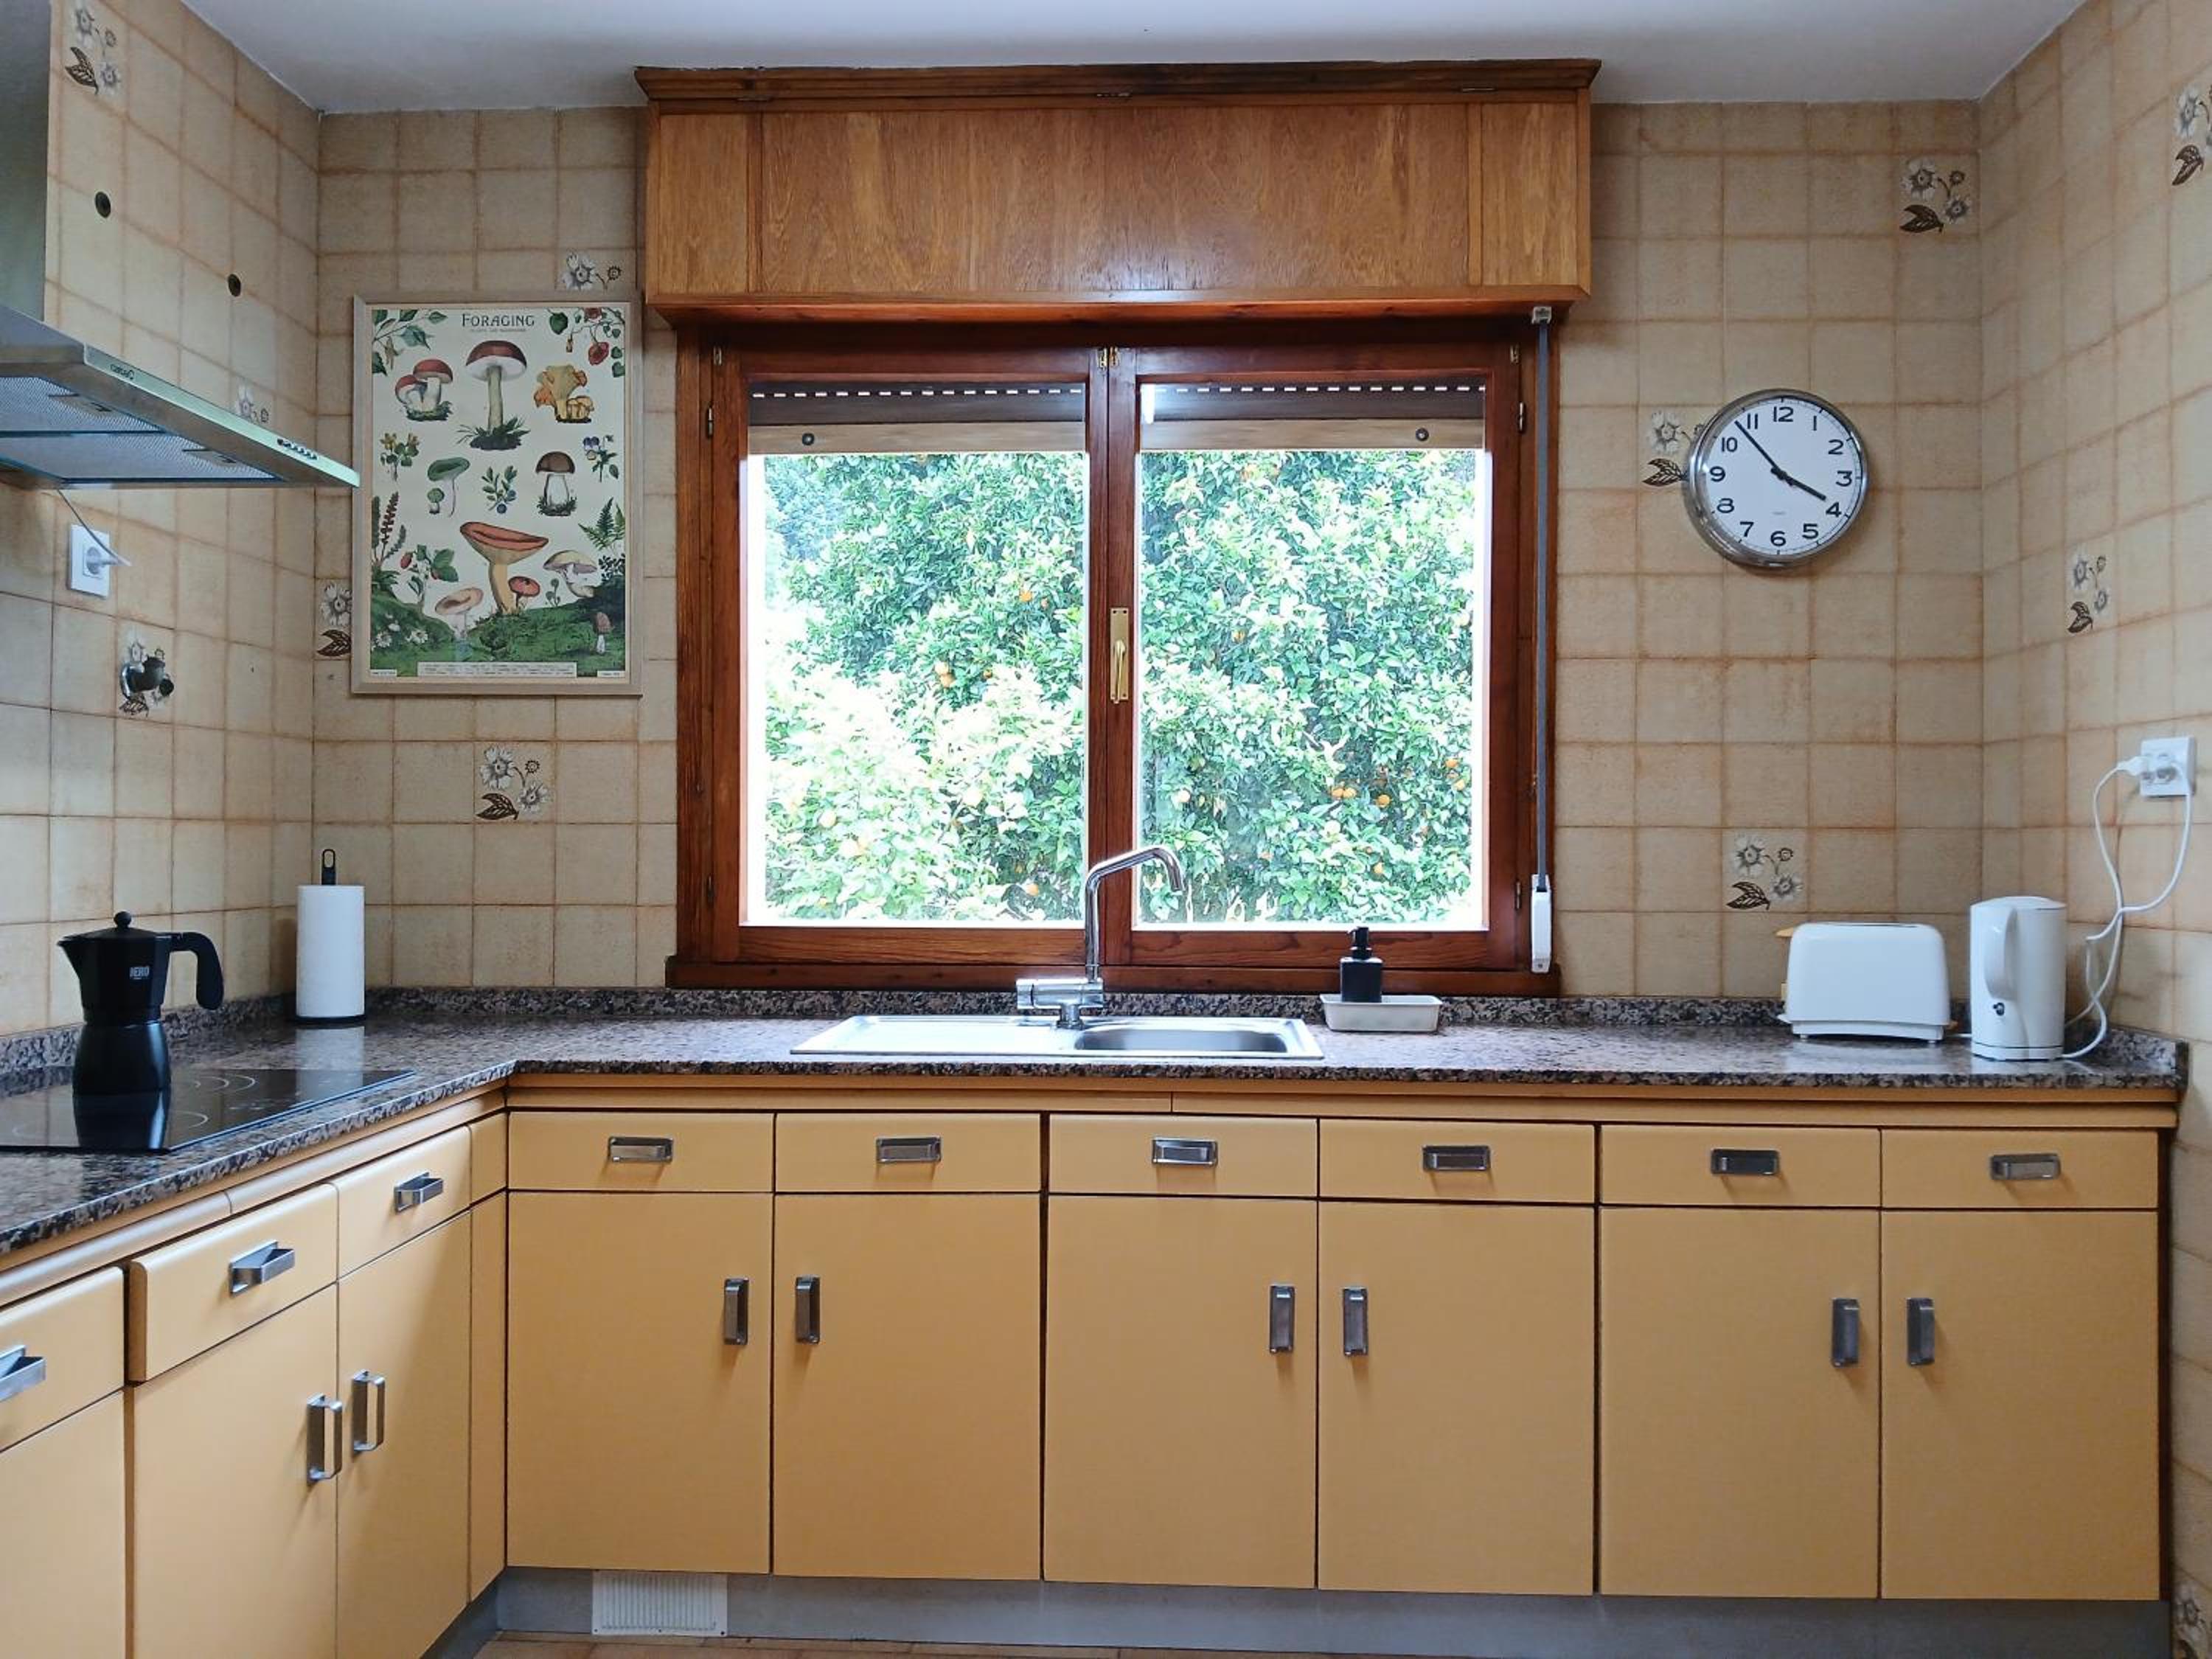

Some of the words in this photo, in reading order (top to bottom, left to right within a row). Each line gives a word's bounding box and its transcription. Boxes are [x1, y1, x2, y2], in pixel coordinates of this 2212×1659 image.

[462, 313, 535, 327] FORAGING
[1747, 414, 1758, 429] 11
[1773, 406, 1793, 422] 12
[1812, 416, 1818, 431] 1
[1722, 437, 1737, 452] 10
[1829, 439, 1843, 455] 2
[1710, 466, 1725, 482] 9
[1836, 470, 1852, 487] 3
[1717, 498, 1734, 513] 8
[1826, 502, 1842, 518] 4
[1740, 521, 1754, 537] 7
[1802, 524, 1818, 540] 5
[1770, 531, 1786, 546] 6
